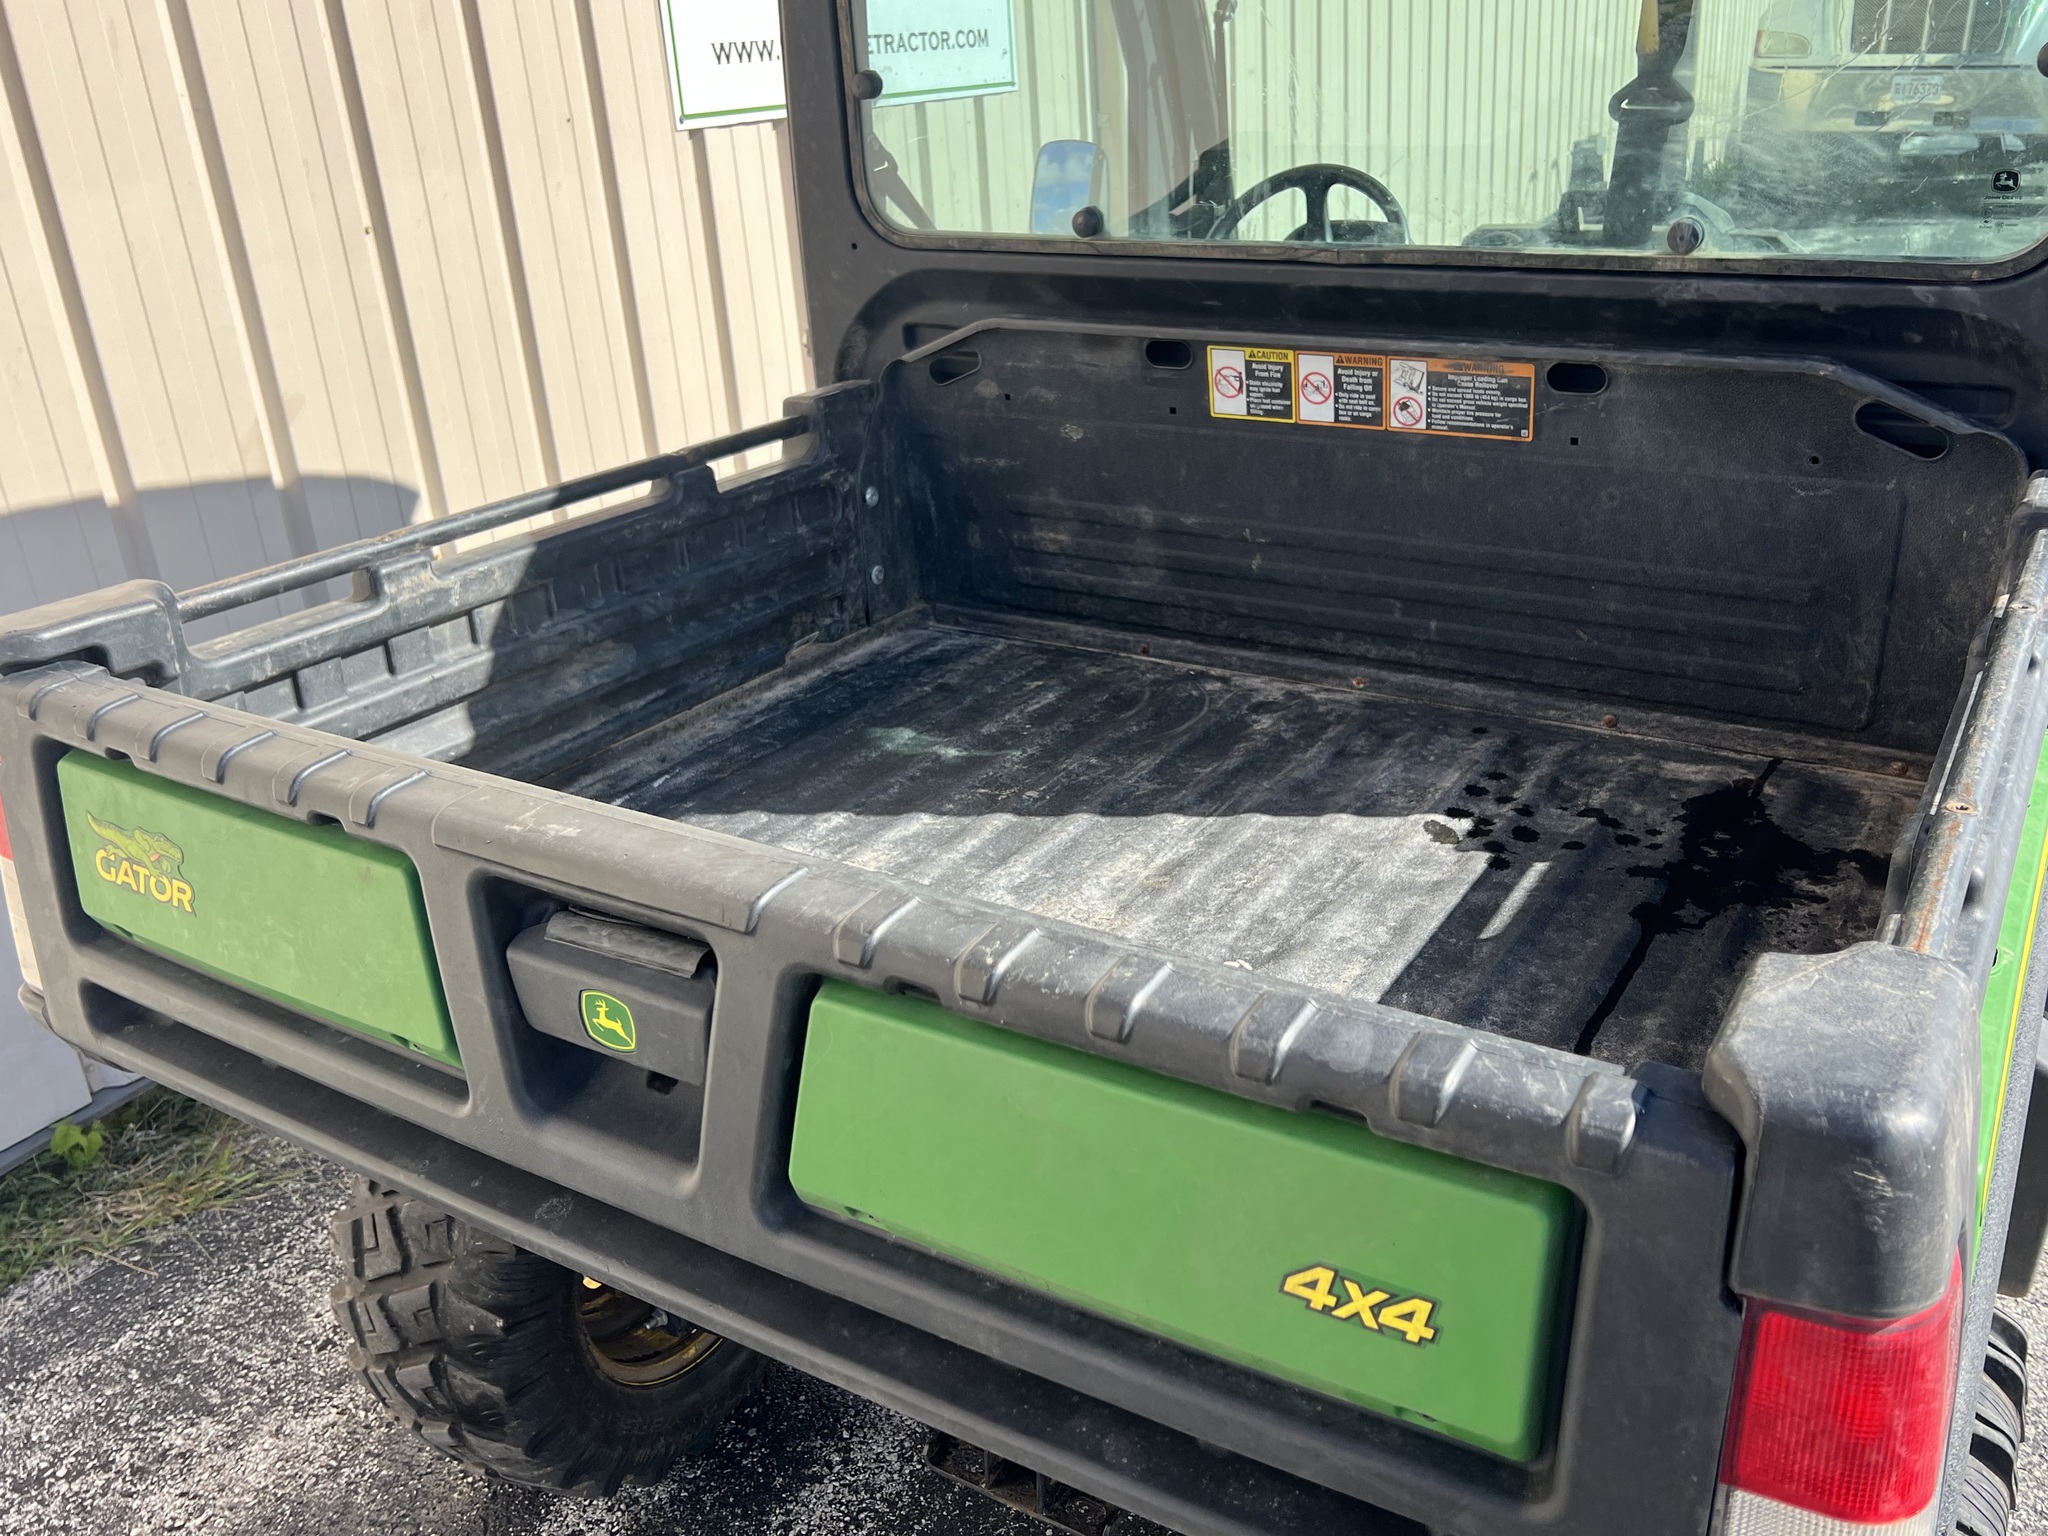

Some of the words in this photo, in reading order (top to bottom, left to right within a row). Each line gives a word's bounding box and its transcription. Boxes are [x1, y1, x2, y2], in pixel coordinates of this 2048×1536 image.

[711, 40, 780, 65] WWW.
[1257, 351, 1288, 360] CAUTION
[1345, 356, 1383, 366] WARNING
[1463, 363, 1504, 373] WARNING
[1343, 384, 1362, 392] Falling
[95, 848, 193, 913] GATOR
[1282, 1265, 1436, 1344] 4X4
